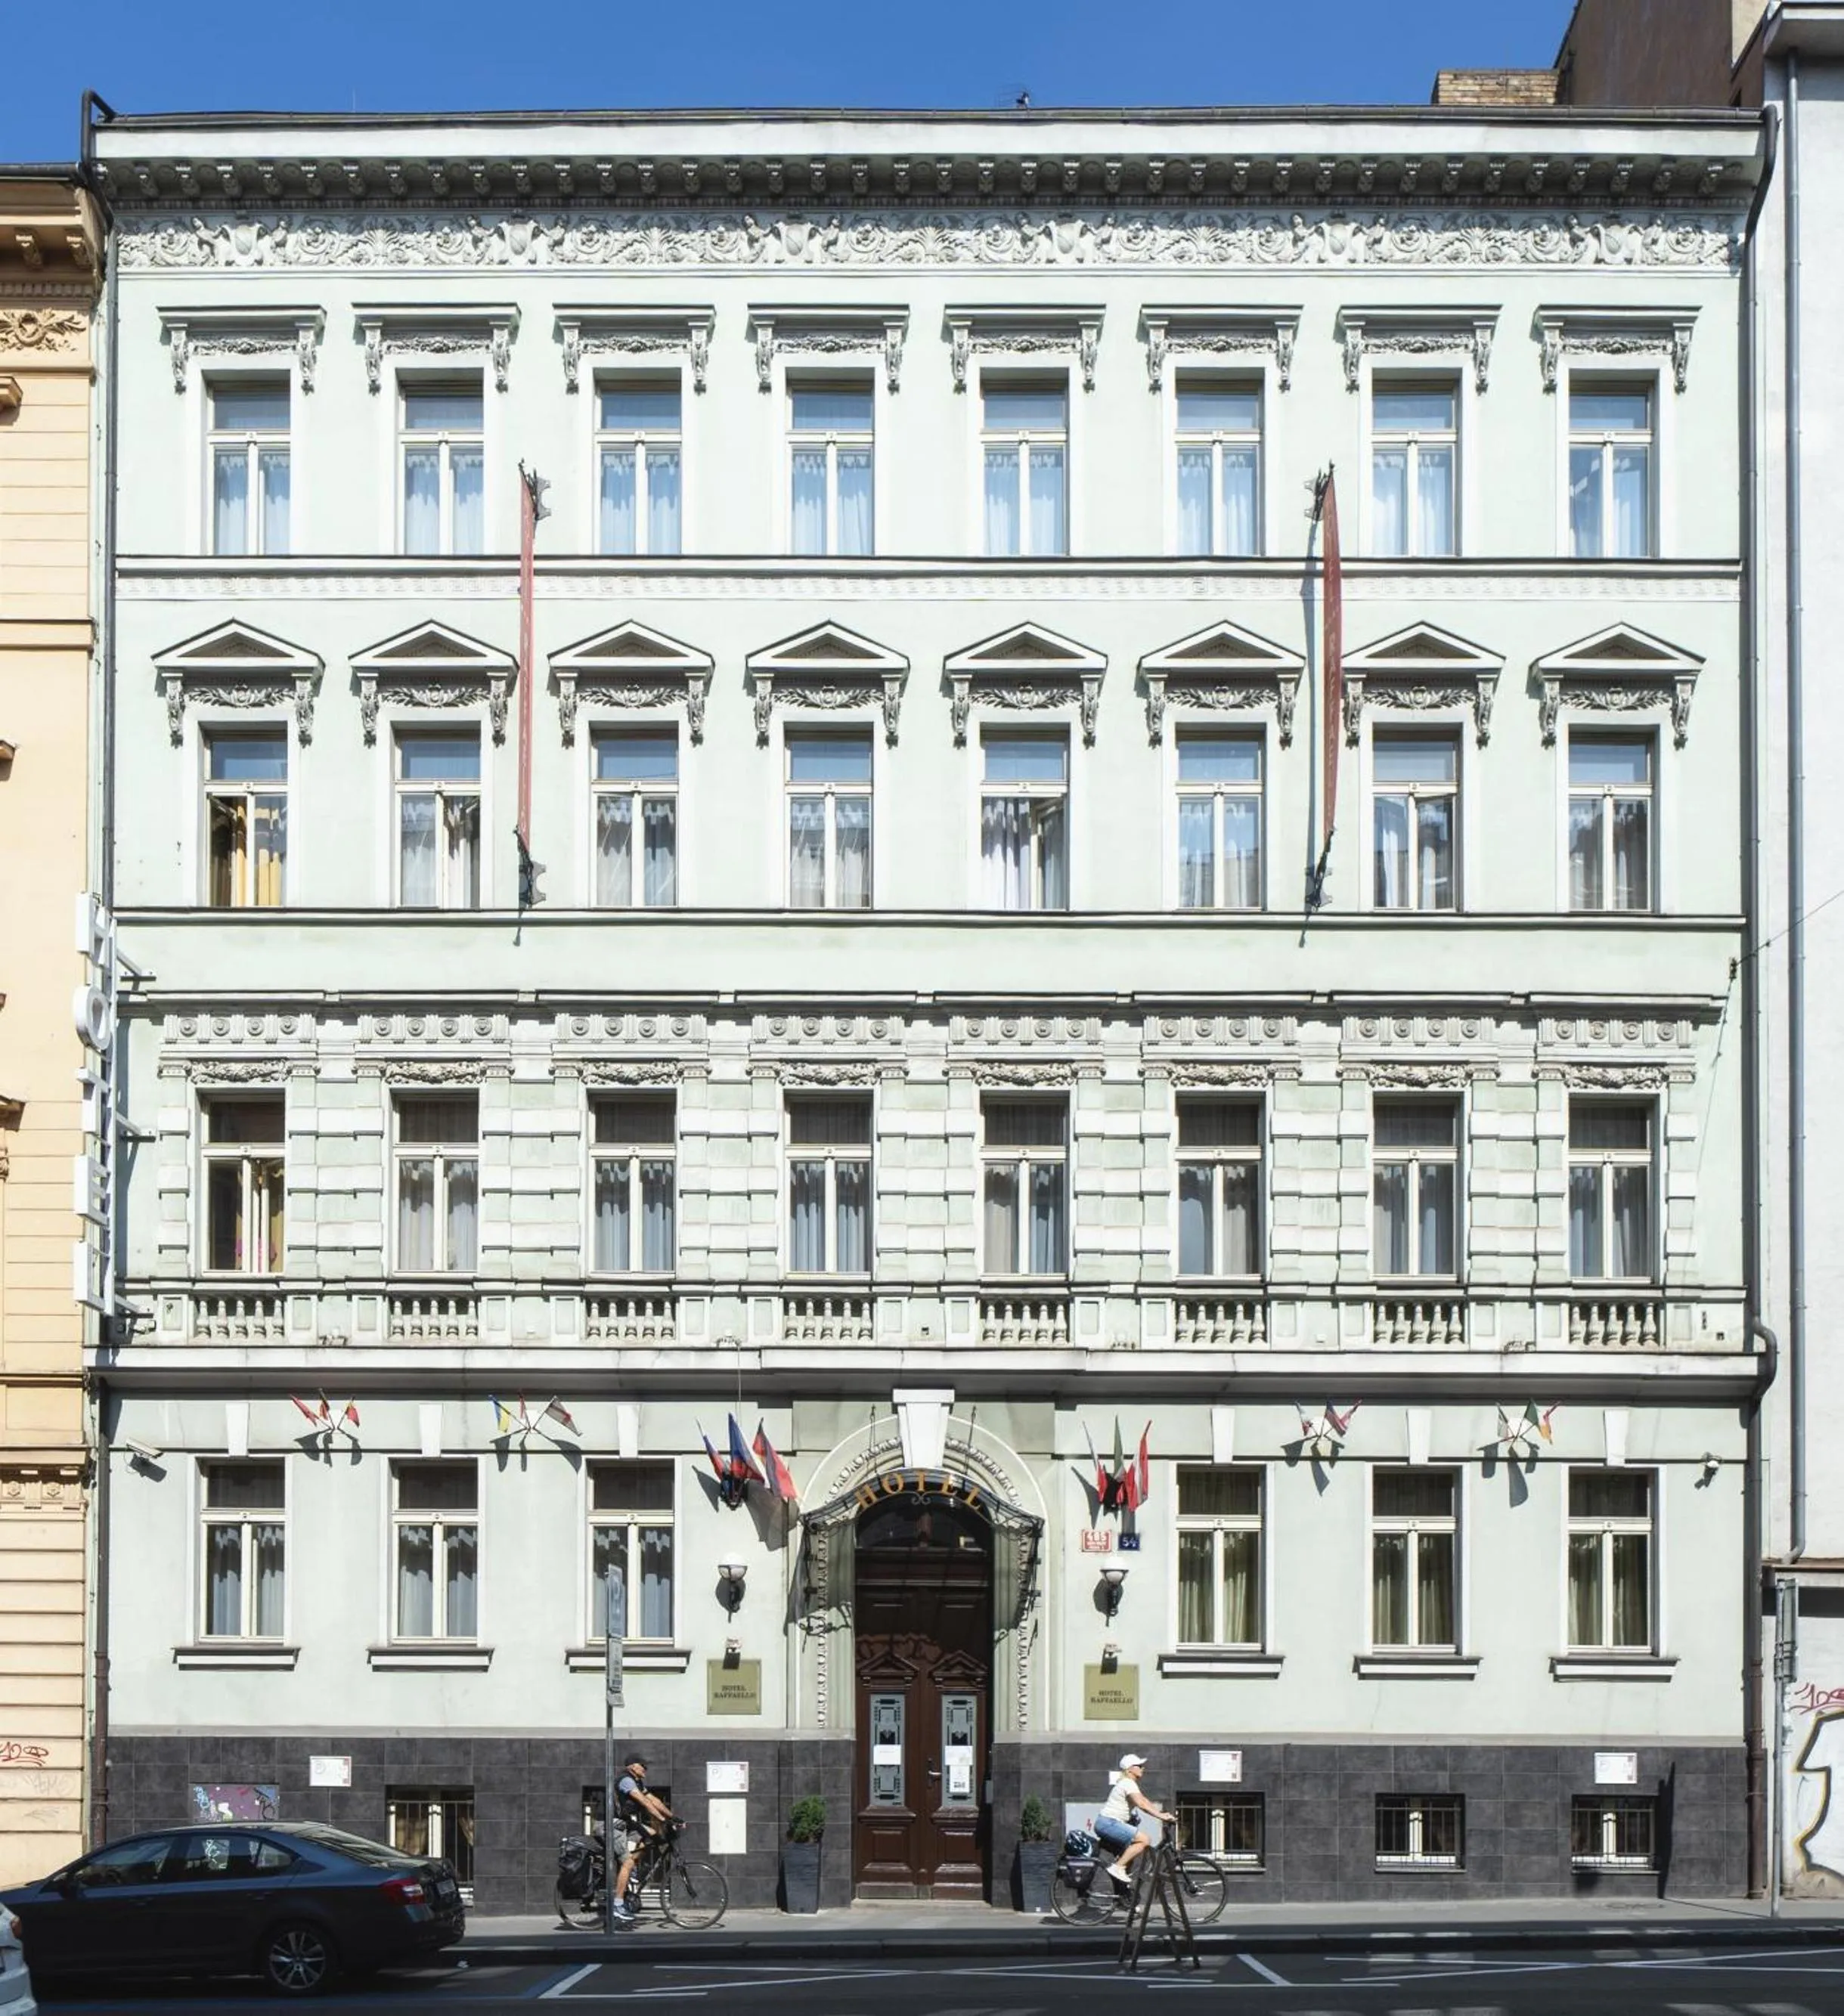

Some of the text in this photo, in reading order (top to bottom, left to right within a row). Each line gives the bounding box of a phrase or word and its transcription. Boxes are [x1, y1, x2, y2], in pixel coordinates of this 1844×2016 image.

[73, 892, 113, 1315] HOTEL
[854, 1469, 981, 1512] HOTEL
[1123, 1536, 1137, 1547] 54
